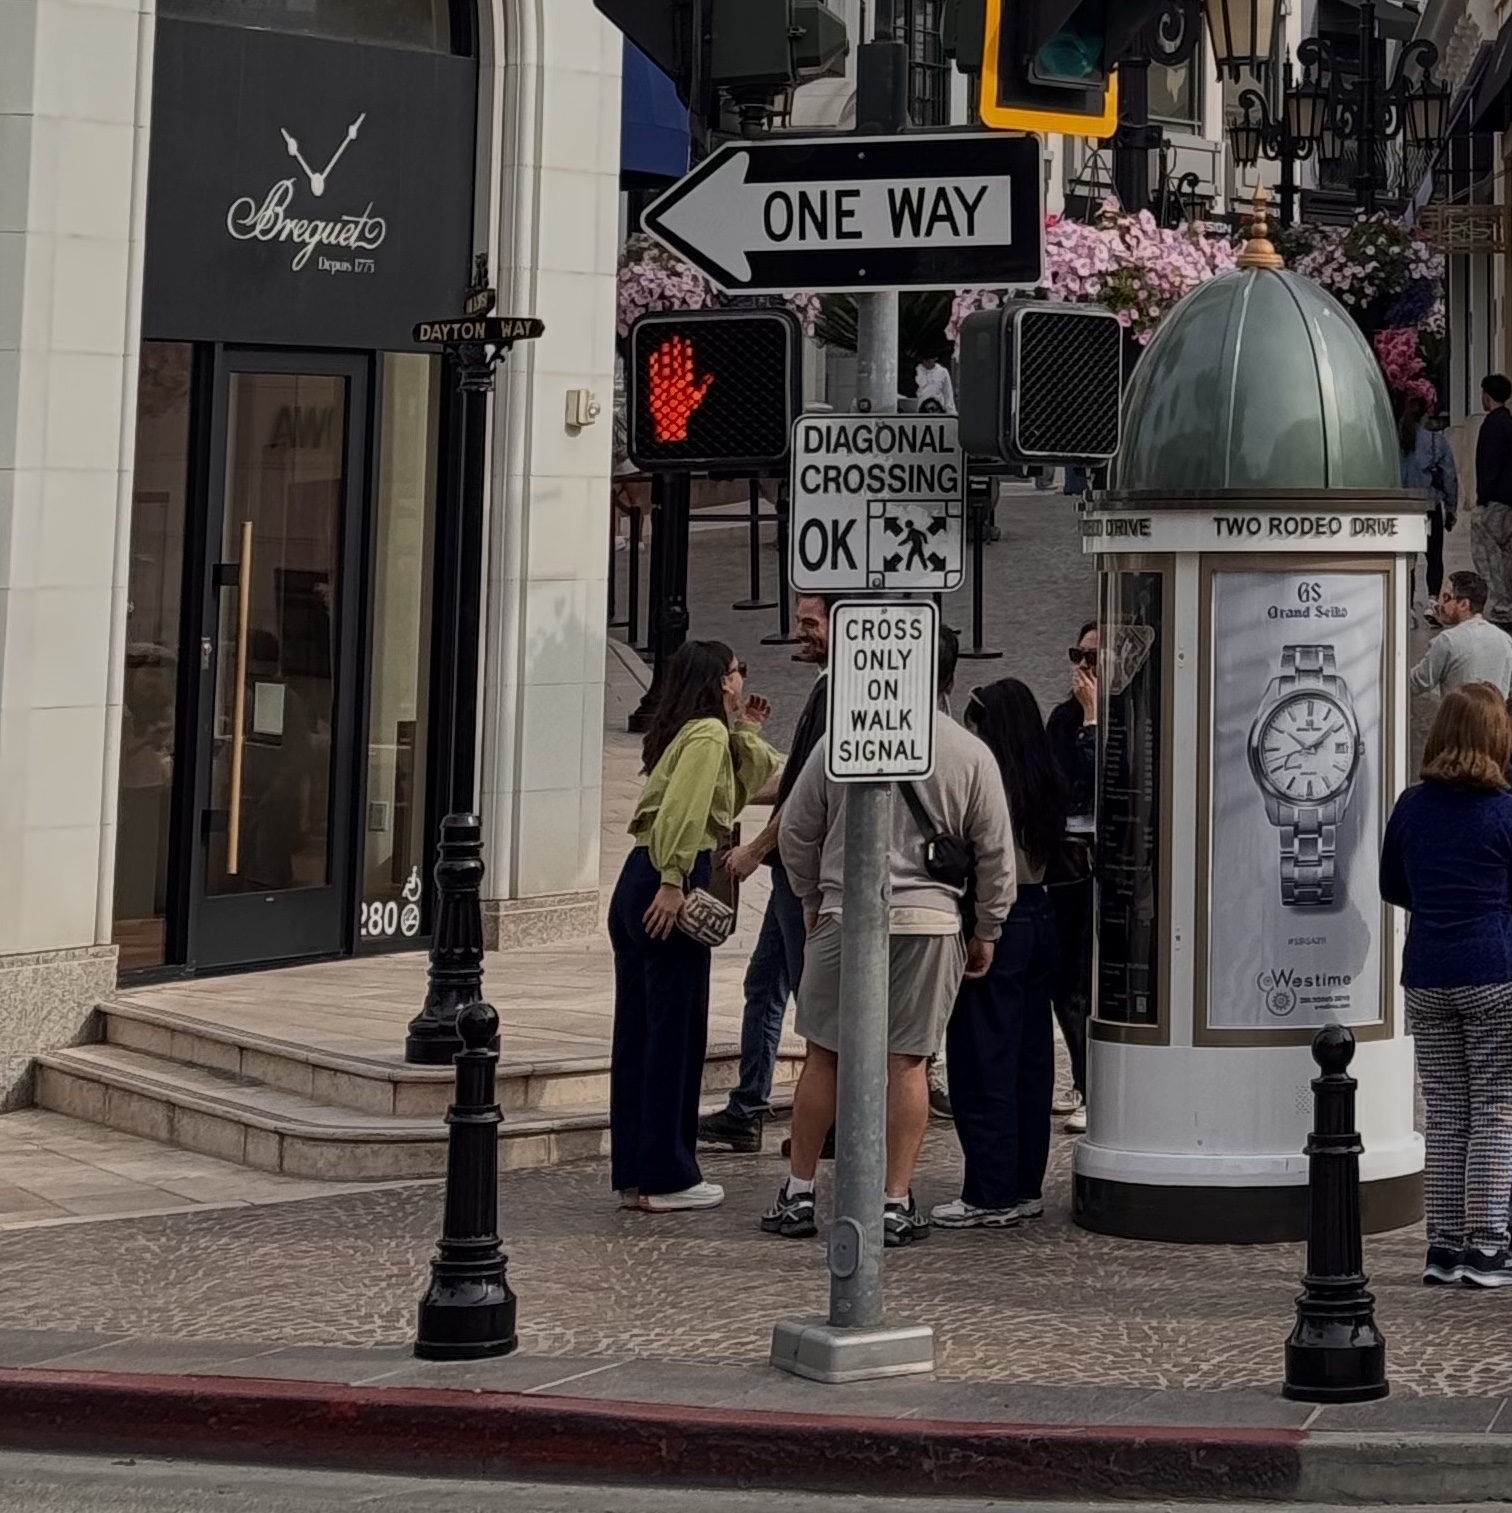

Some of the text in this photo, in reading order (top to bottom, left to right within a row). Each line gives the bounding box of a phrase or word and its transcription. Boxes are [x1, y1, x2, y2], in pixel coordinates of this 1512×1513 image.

[227, 178, 386, 271] Breguet
[763, 185, 989, 243] ONE WAY
[319, 257, 352, 275] Depuis
[420, 320, 533, 341] DAYTON WAY
[803, 425, 955, 454] DIAGONAL
[800, 464, 958, 494] CROSSING
[1105, 517, 1152, 536] DRIVE
[1213, 517, 1399, 536] TWO RODEO DRIVE
[799, 518, 858, 572] OK
[846, 619, 923, 641] CROSS
[854, 649, 912, 671] ONLY
[867, 679, 898, 701] ON
[851, 709, 913, 731] WALK
[839, 739, 923, 762] SIGNAL
[1271, 968, 1352, 989] Westime
